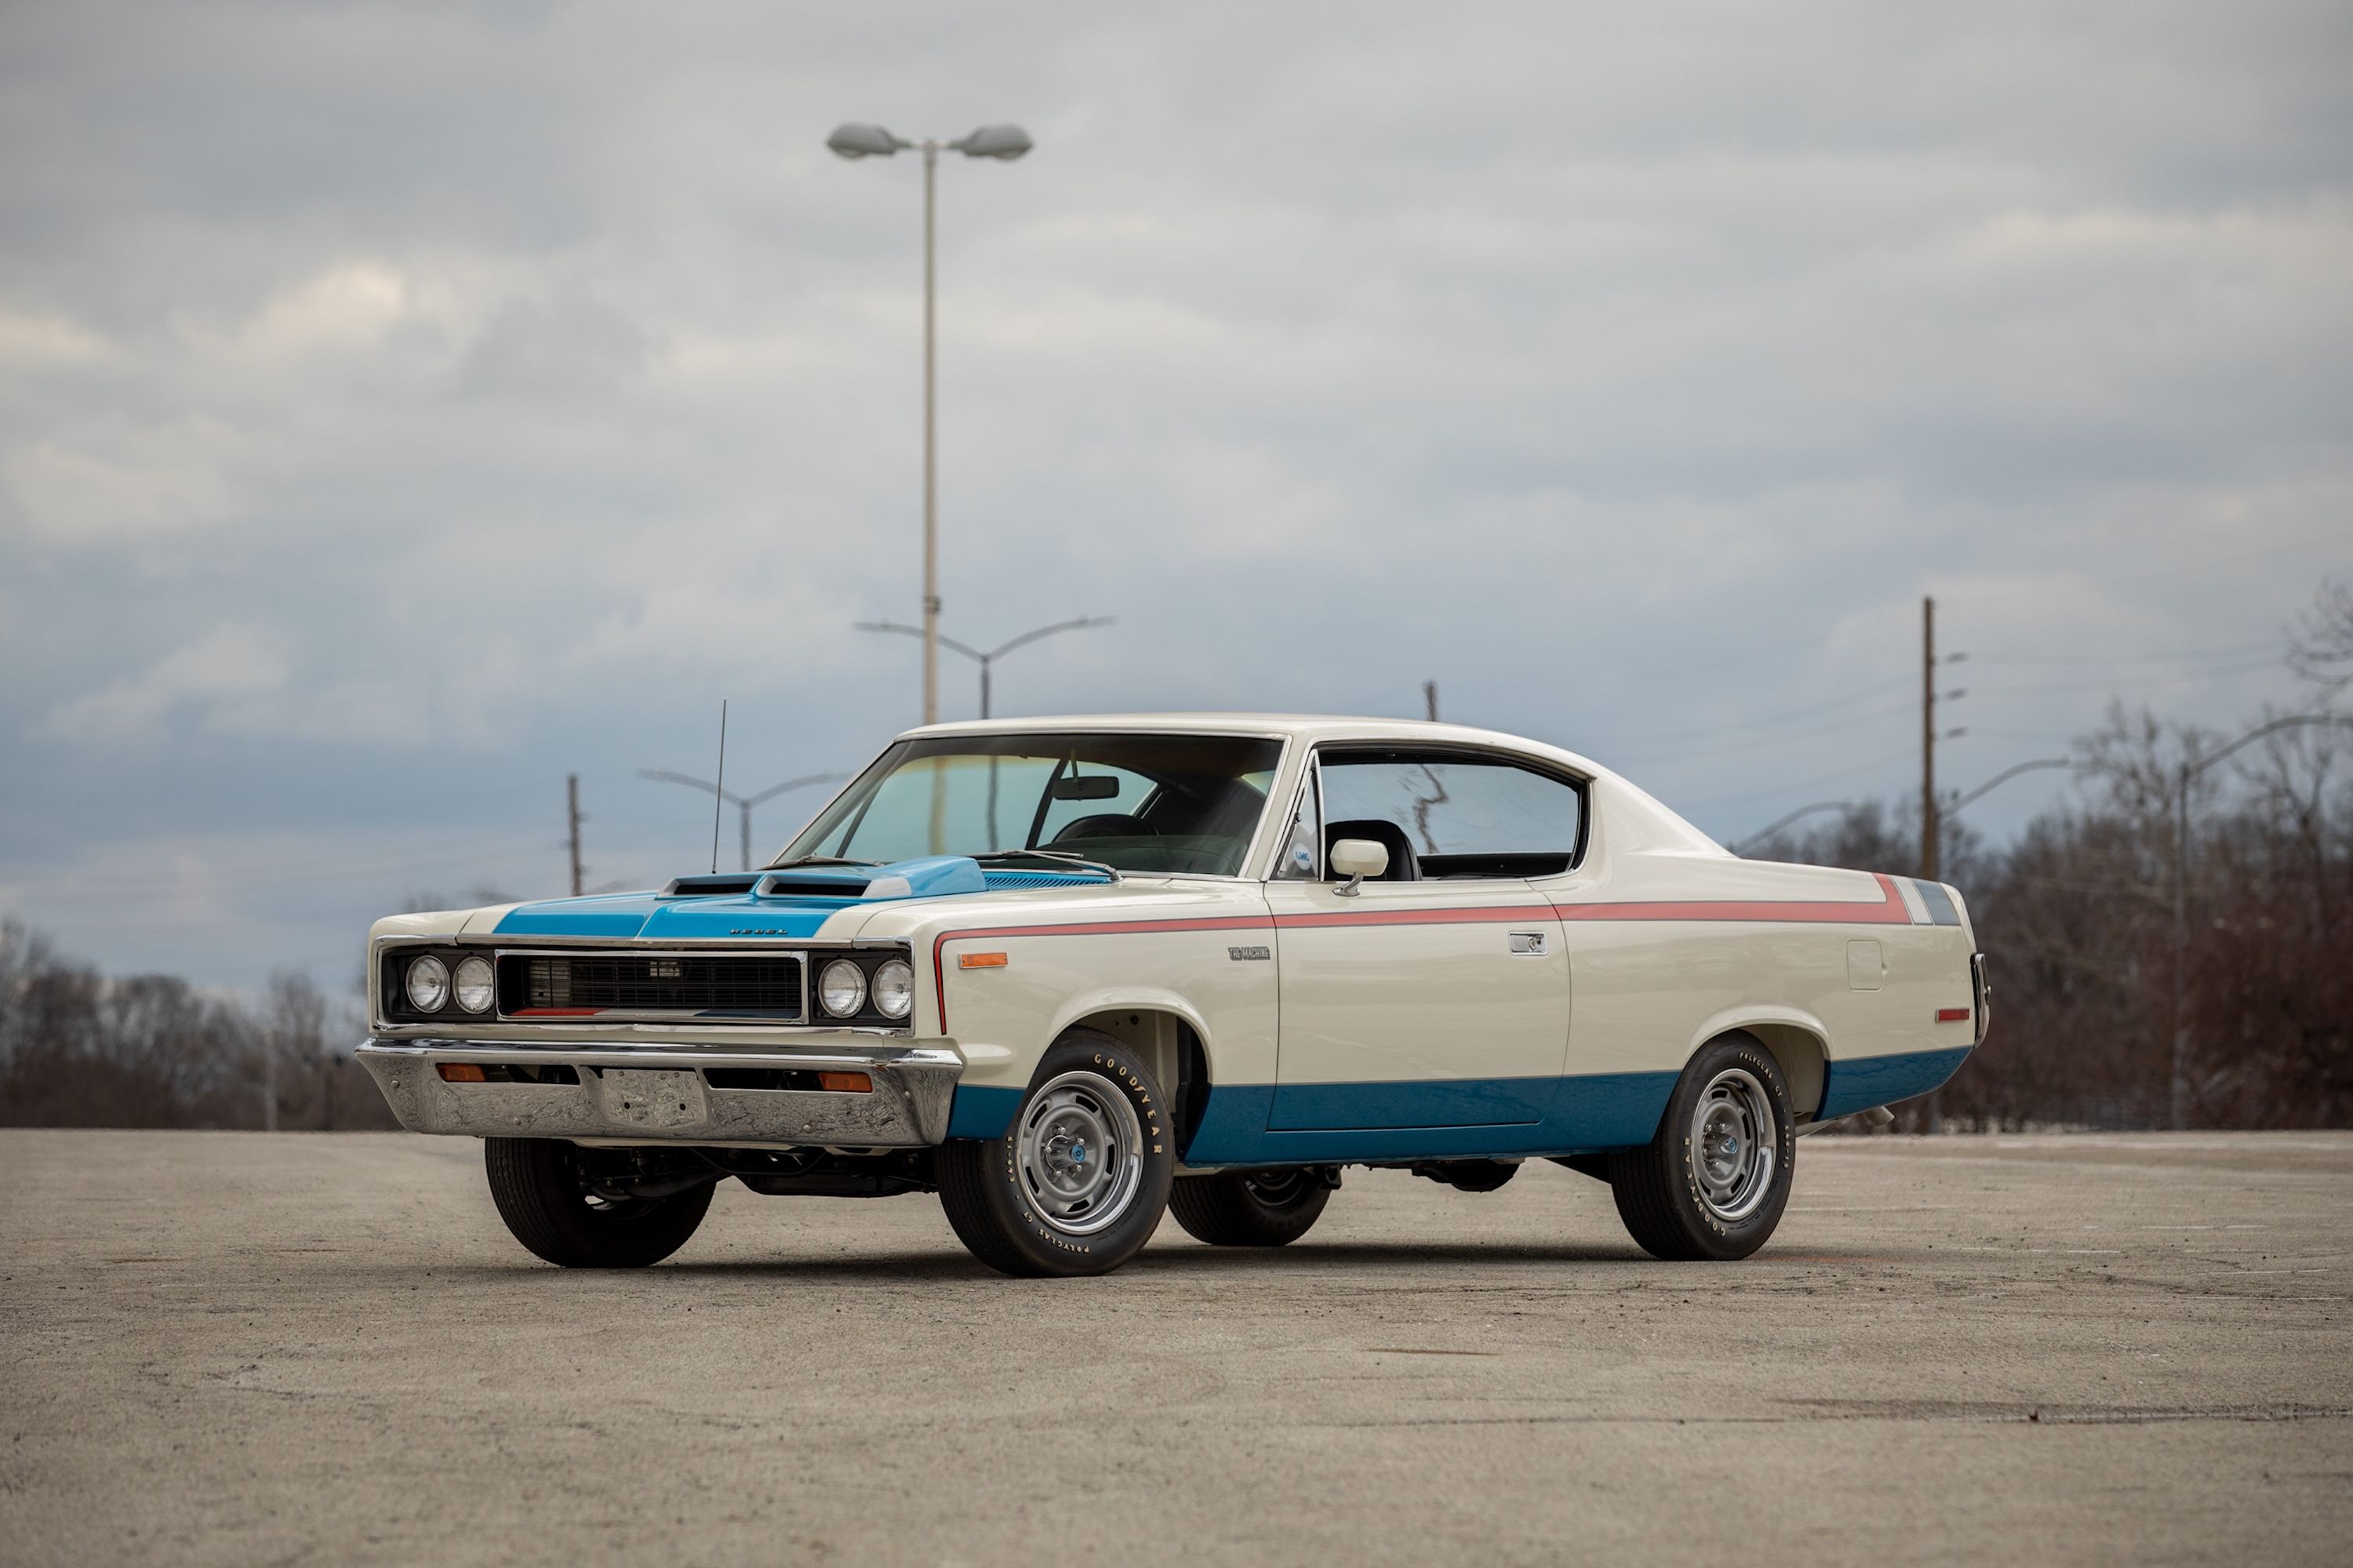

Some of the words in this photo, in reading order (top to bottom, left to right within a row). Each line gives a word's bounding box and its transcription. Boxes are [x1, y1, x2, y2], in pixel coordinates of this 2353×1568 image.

[1228, 947, 1242, 961] THE
[1242, 946, 1271, 961] MACHINE
[1738, 1051, 1773, 1079] POLYGLAS
[1093, 1053, 1162, 1155] GOODYEAR
[1684, 1137, 1726, 1237] GOODYEAR
[1038, 1228, 1090, 1253] POLYGLAS
